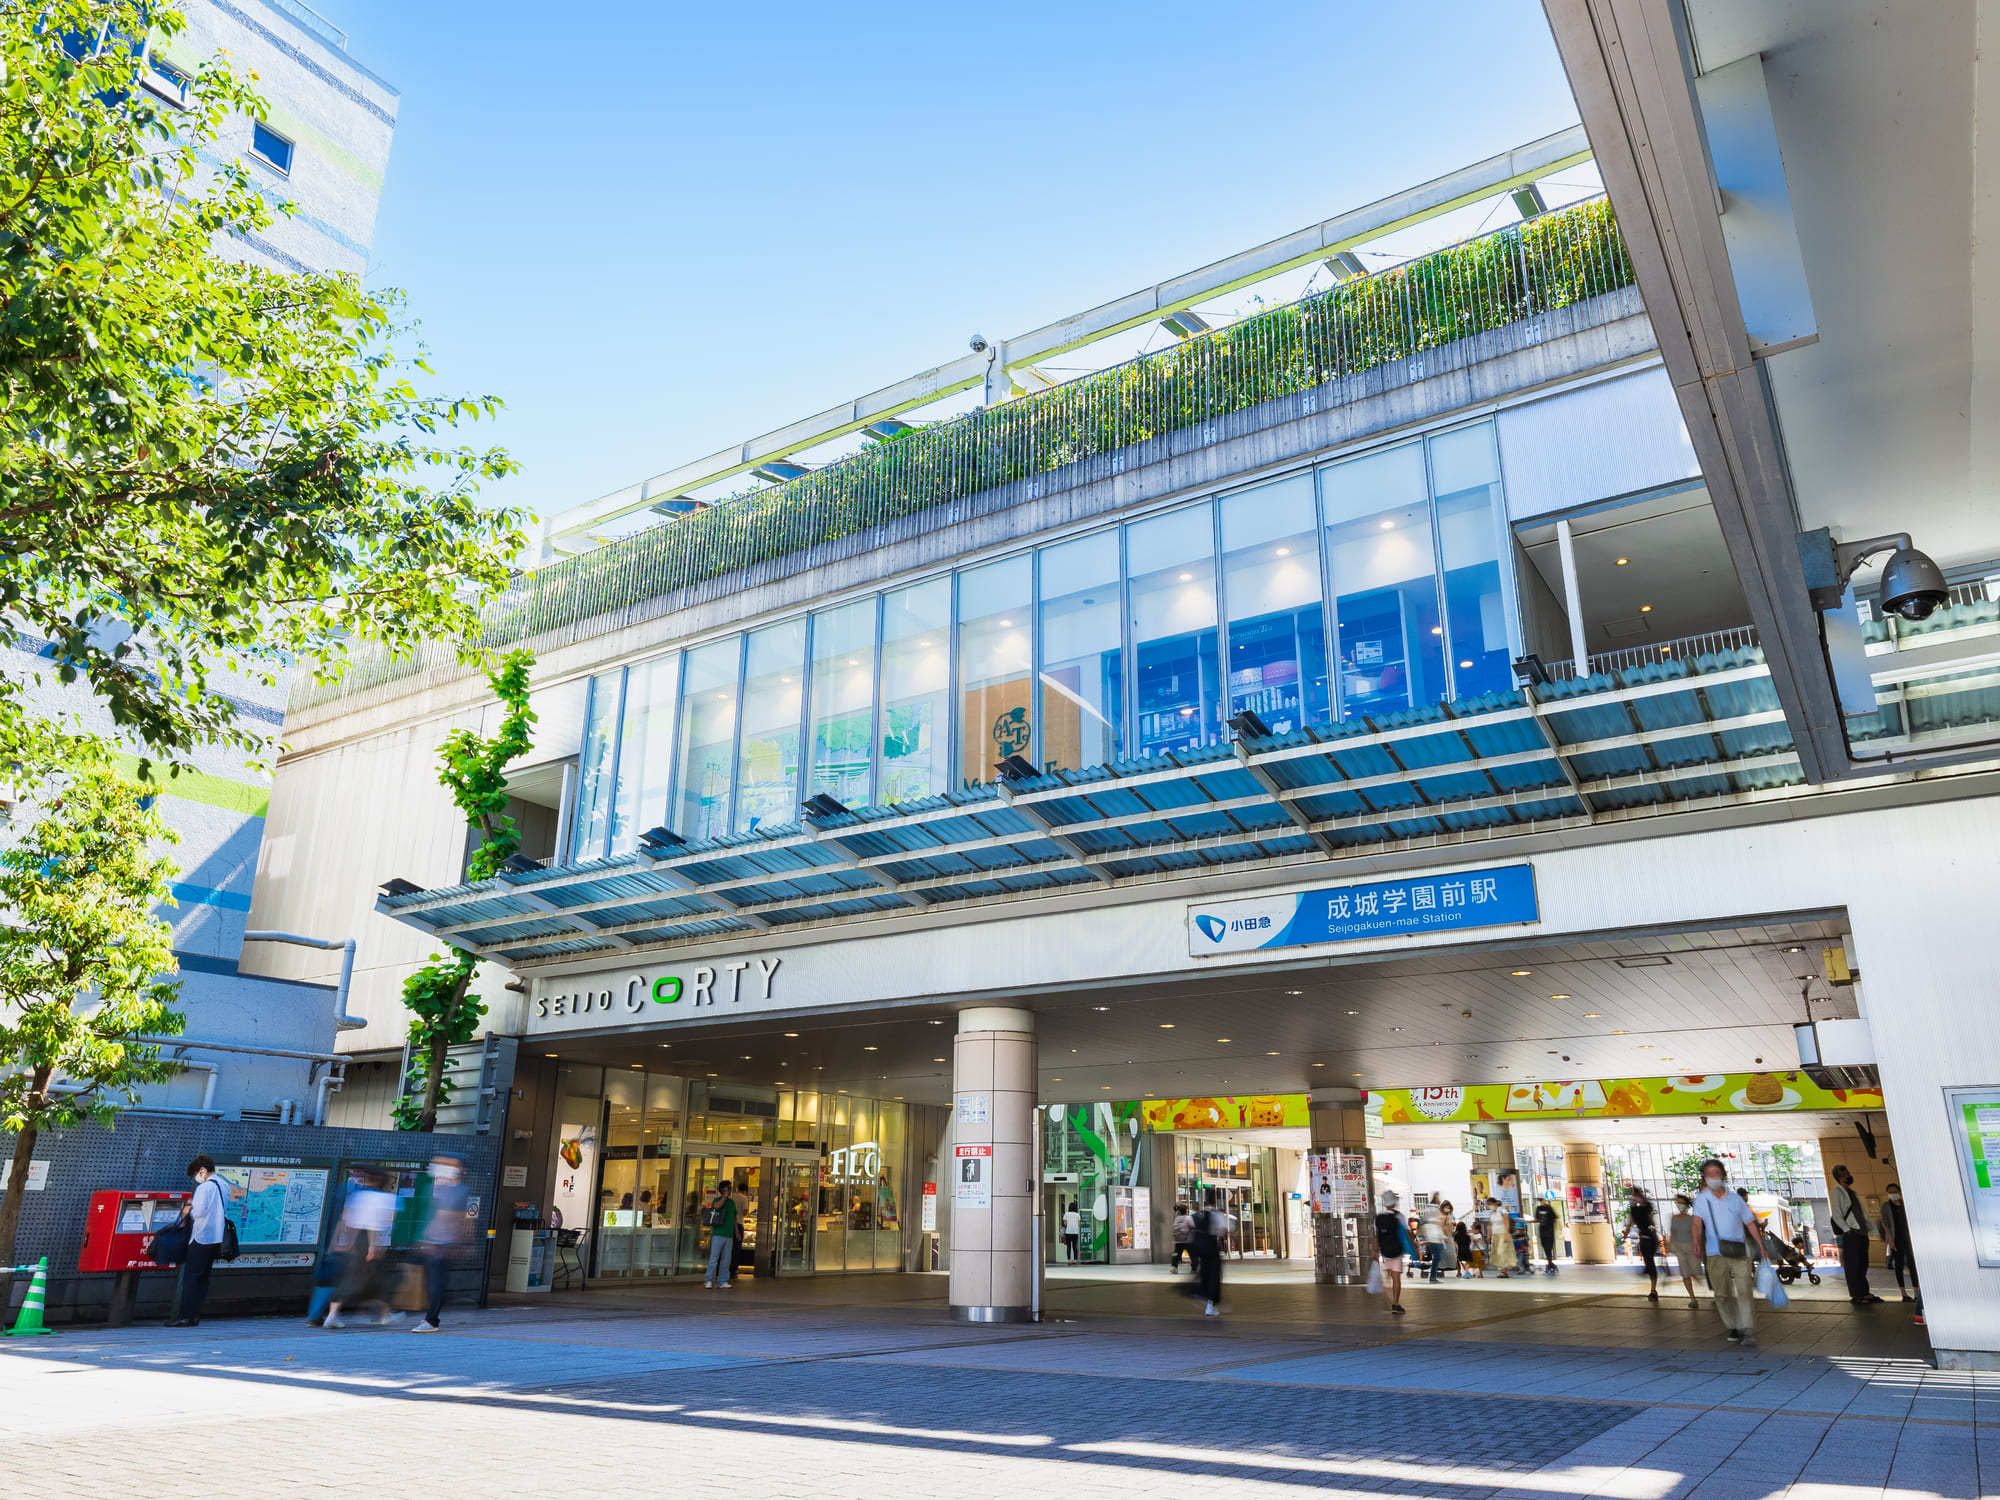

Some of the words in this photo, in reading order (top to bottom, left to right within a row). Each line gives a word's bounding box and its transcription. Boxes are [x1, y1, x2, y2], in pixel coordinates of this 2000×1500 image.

[1328, 877, 1498, 920] 成城学園前駅
[1231, 916, 1272, 932] 小田急
[1328, 916, 1419, 935] Seijogakuen-mae
[1422, 911, 1462, 924] Station
[536, 990, 612, 1017] SEIJO
[626, 957, 782, 1014] CORTY
[1422, 1087, 1459, 1100] 15th
[831, 1142, 881, 1178] FLO
